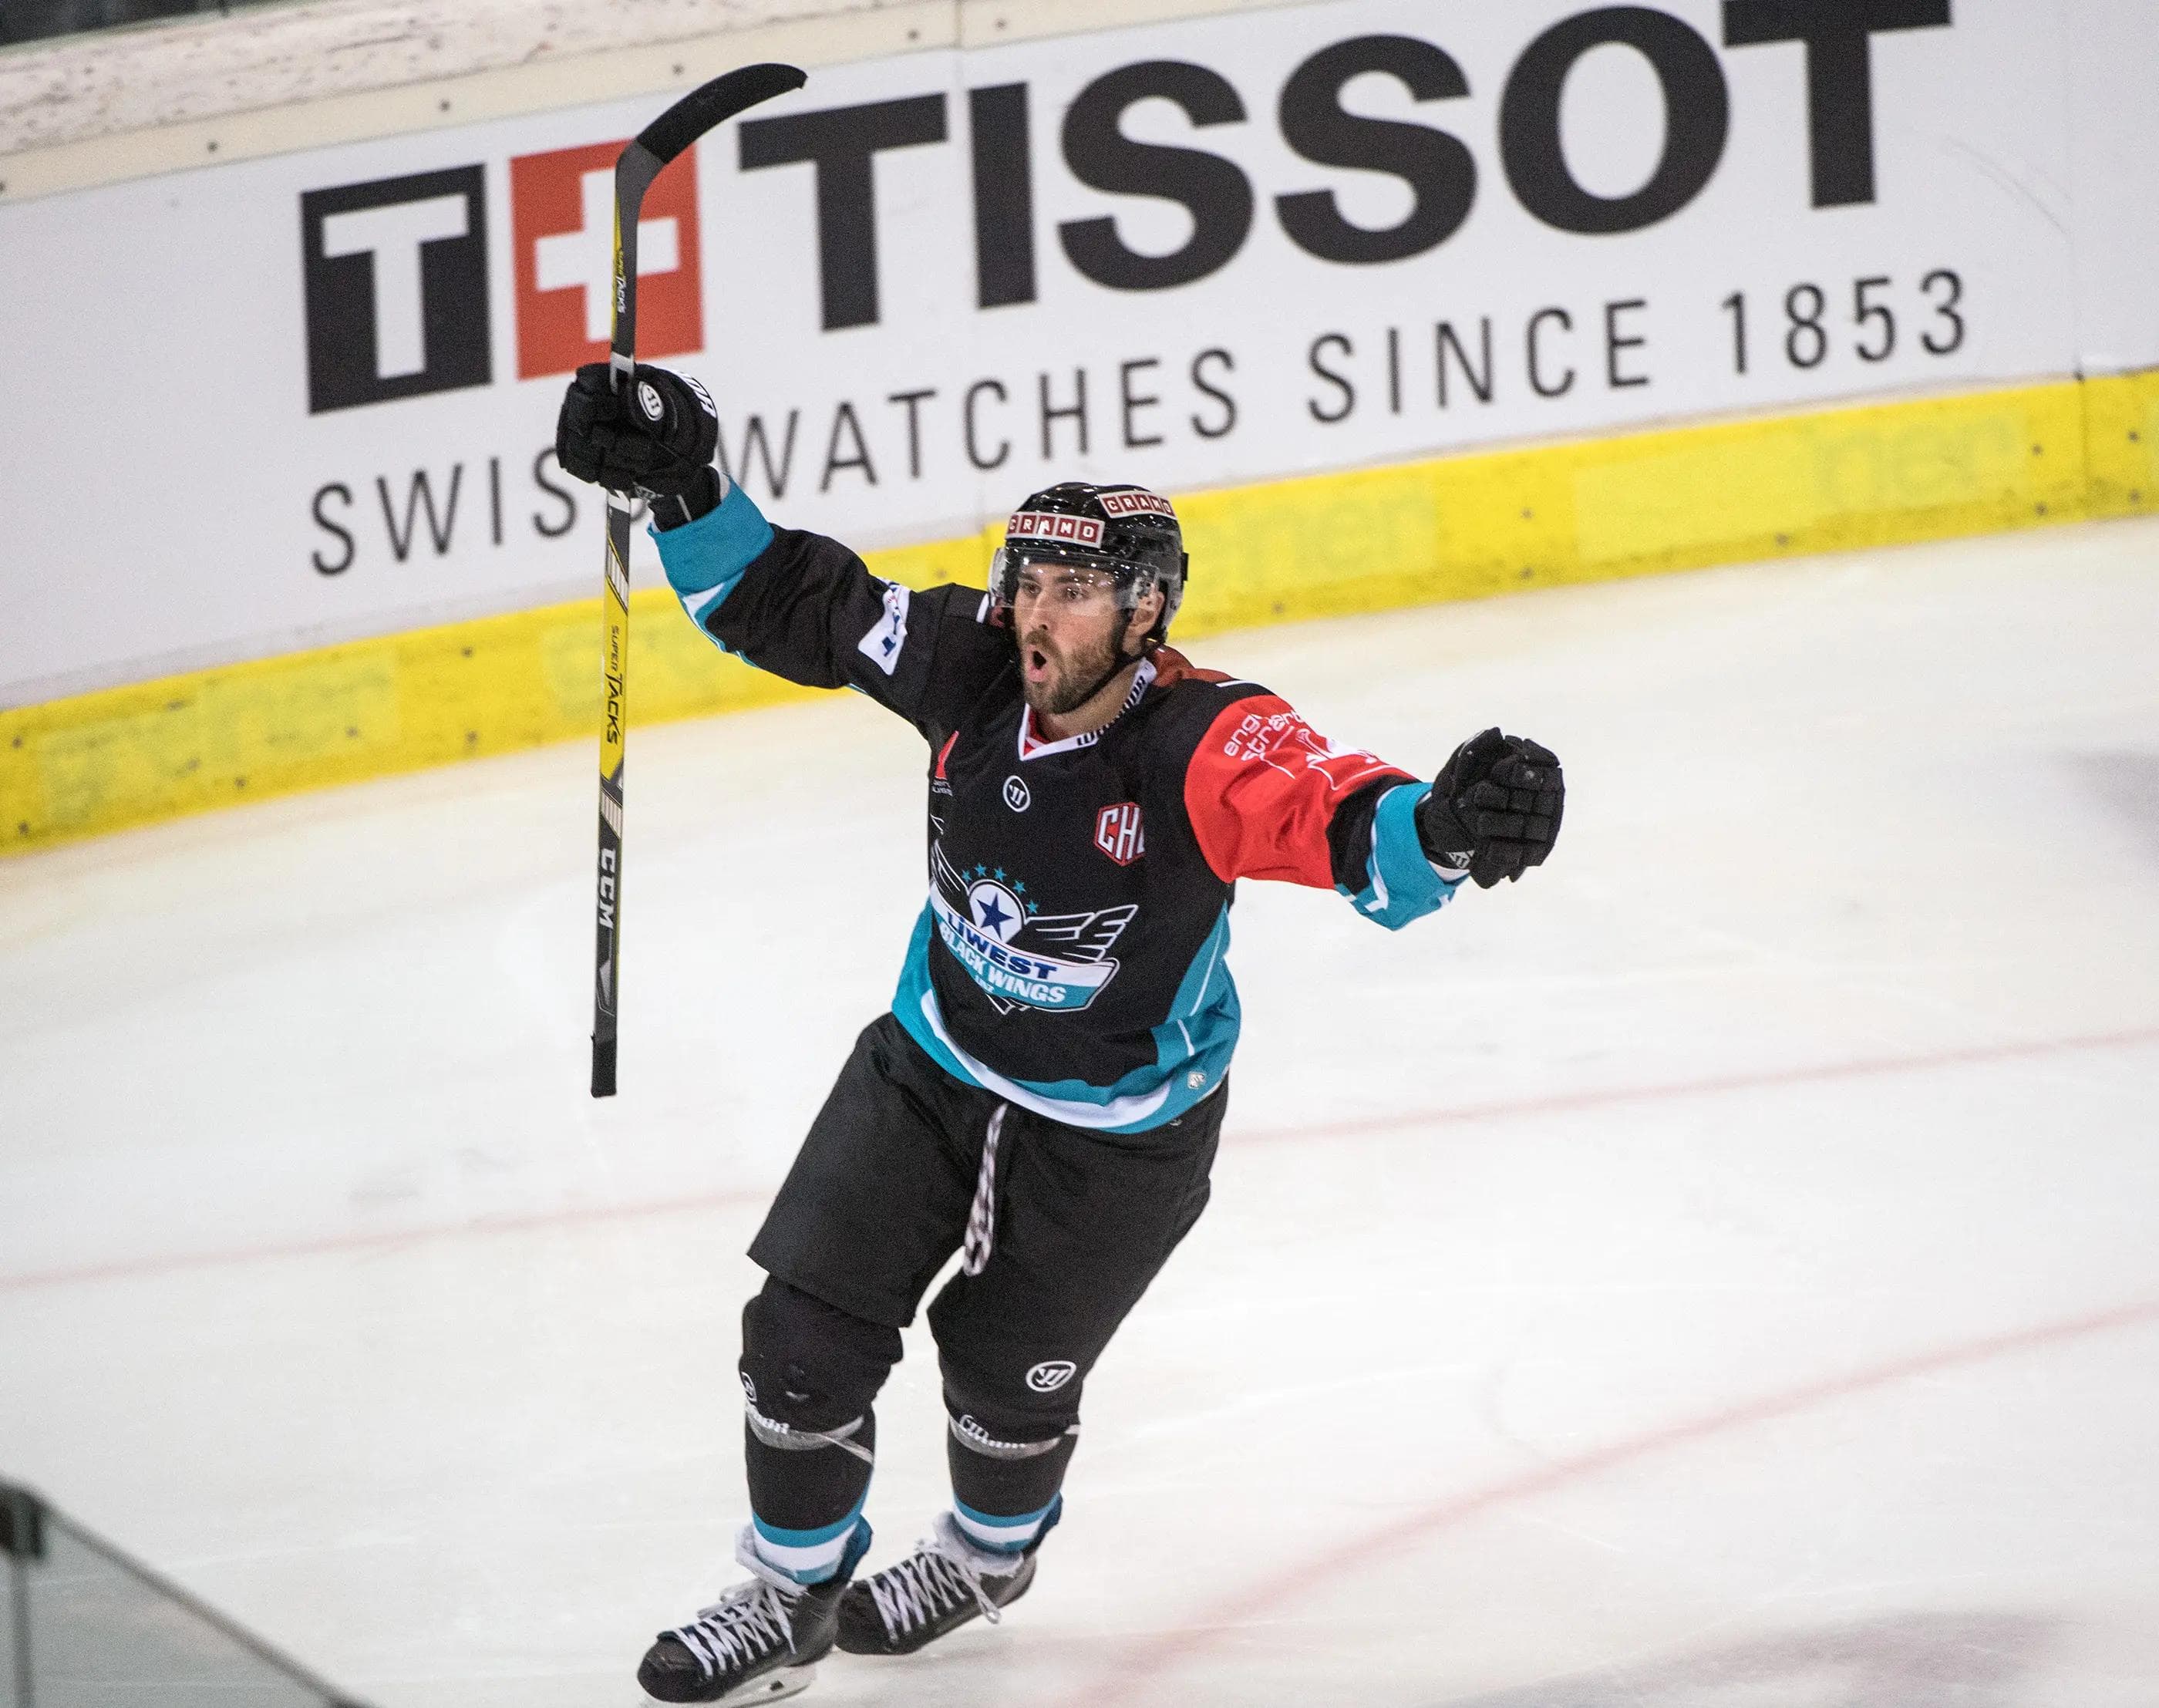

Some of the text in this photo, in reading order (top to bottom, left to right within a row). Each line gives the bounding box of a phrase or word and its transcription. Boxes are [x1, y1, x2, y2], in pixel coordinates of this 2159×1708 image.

[737, 0, 1953, 332] TISSOT
[311, 446, 648, 576] SWIS
[716, 347, 1237, 500] WATCHES
[1309, 299, 1651, 423] SINCE
[1720, 268, 1965, 375] 1853
[1009, 518, 1095, 538] CRAMO
[1107, 496, 1172, 514] CRAMO
[605, 625, 624, 745] SUPER TACKS
[598, 847, 617, 929] CCM
[940, 921, 1066, 1003] BLACK WINGS
